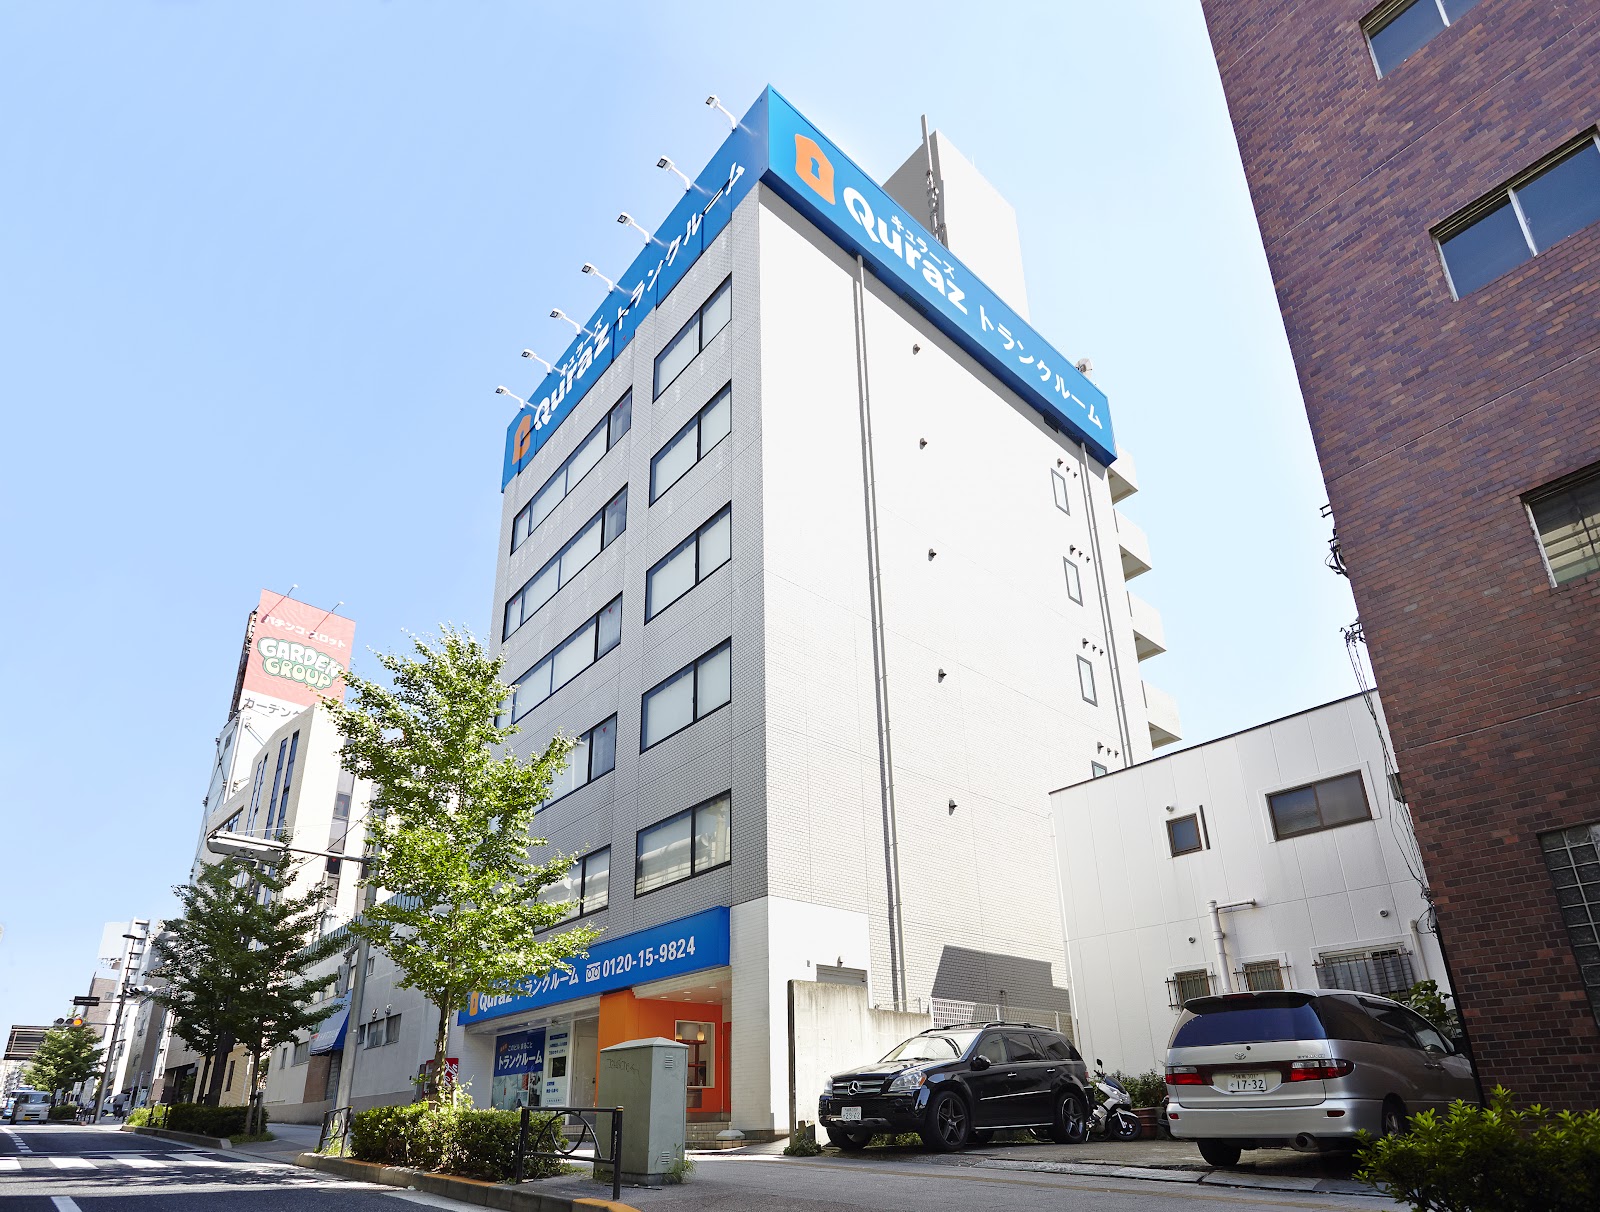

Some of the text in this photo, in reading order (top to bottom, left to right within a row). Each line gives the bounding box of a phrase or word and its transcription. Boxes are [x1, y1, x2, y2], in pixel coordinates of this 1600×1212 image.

[617, 161, 745, 331] トランクルーム
[843, 186, 968, 315] Quraz
[890, 214, 956, 280] キュラーズ
[533, 322, 610, 430] Quraz
[979, 304, 1104, 430] トランクルーム
[259, 638, 345, 679] GARDEN
[264, 656, 334, 689] GROUP
[602, 935, 696, 978] 0120-15-9824
[498, 1049, 543, 1071] トランクルーム
[1237, 1079, 1263, 1090] 17-32
